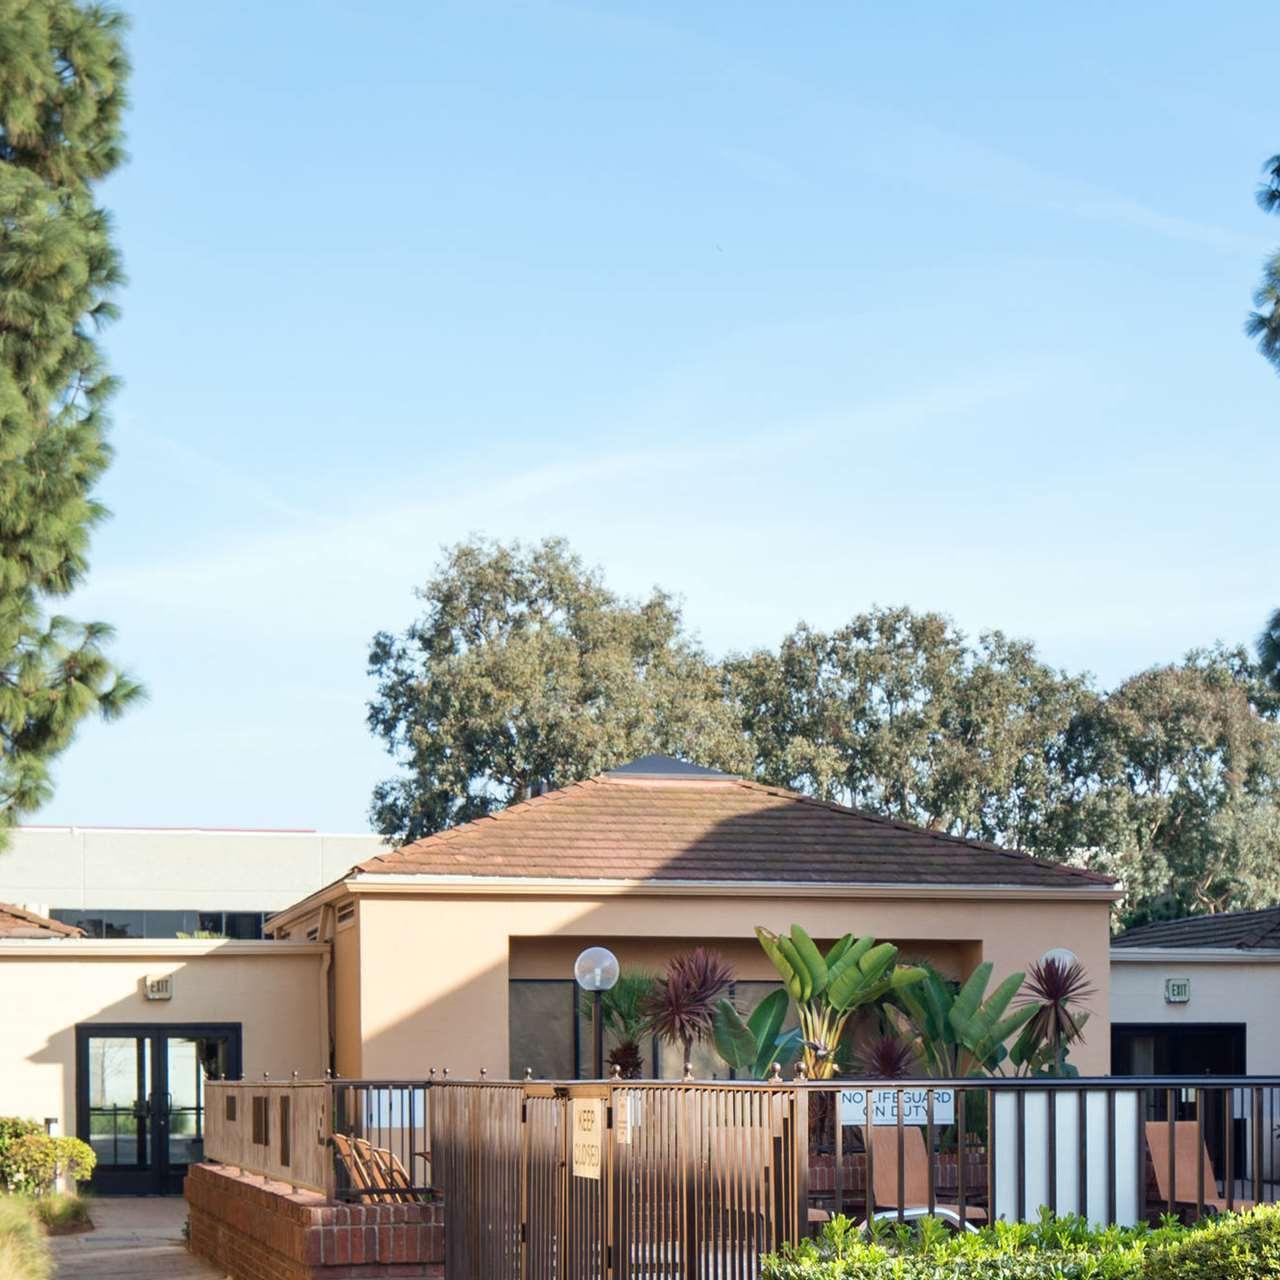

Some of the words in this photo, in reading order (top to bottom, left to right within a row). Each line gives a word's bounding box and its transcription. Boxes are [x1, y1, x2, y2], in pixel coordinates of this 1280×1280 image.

[150, 980, 168, 992] EXIT
[1172, 984, 1186, 996] EXIT
[842, 1092, 864, 1104] NO
[872, 1092, 952, 1104] IFEGURD
[891, 1106, 928, 1117] DUTY
[579, 1110, 595, 1132] KEEP
